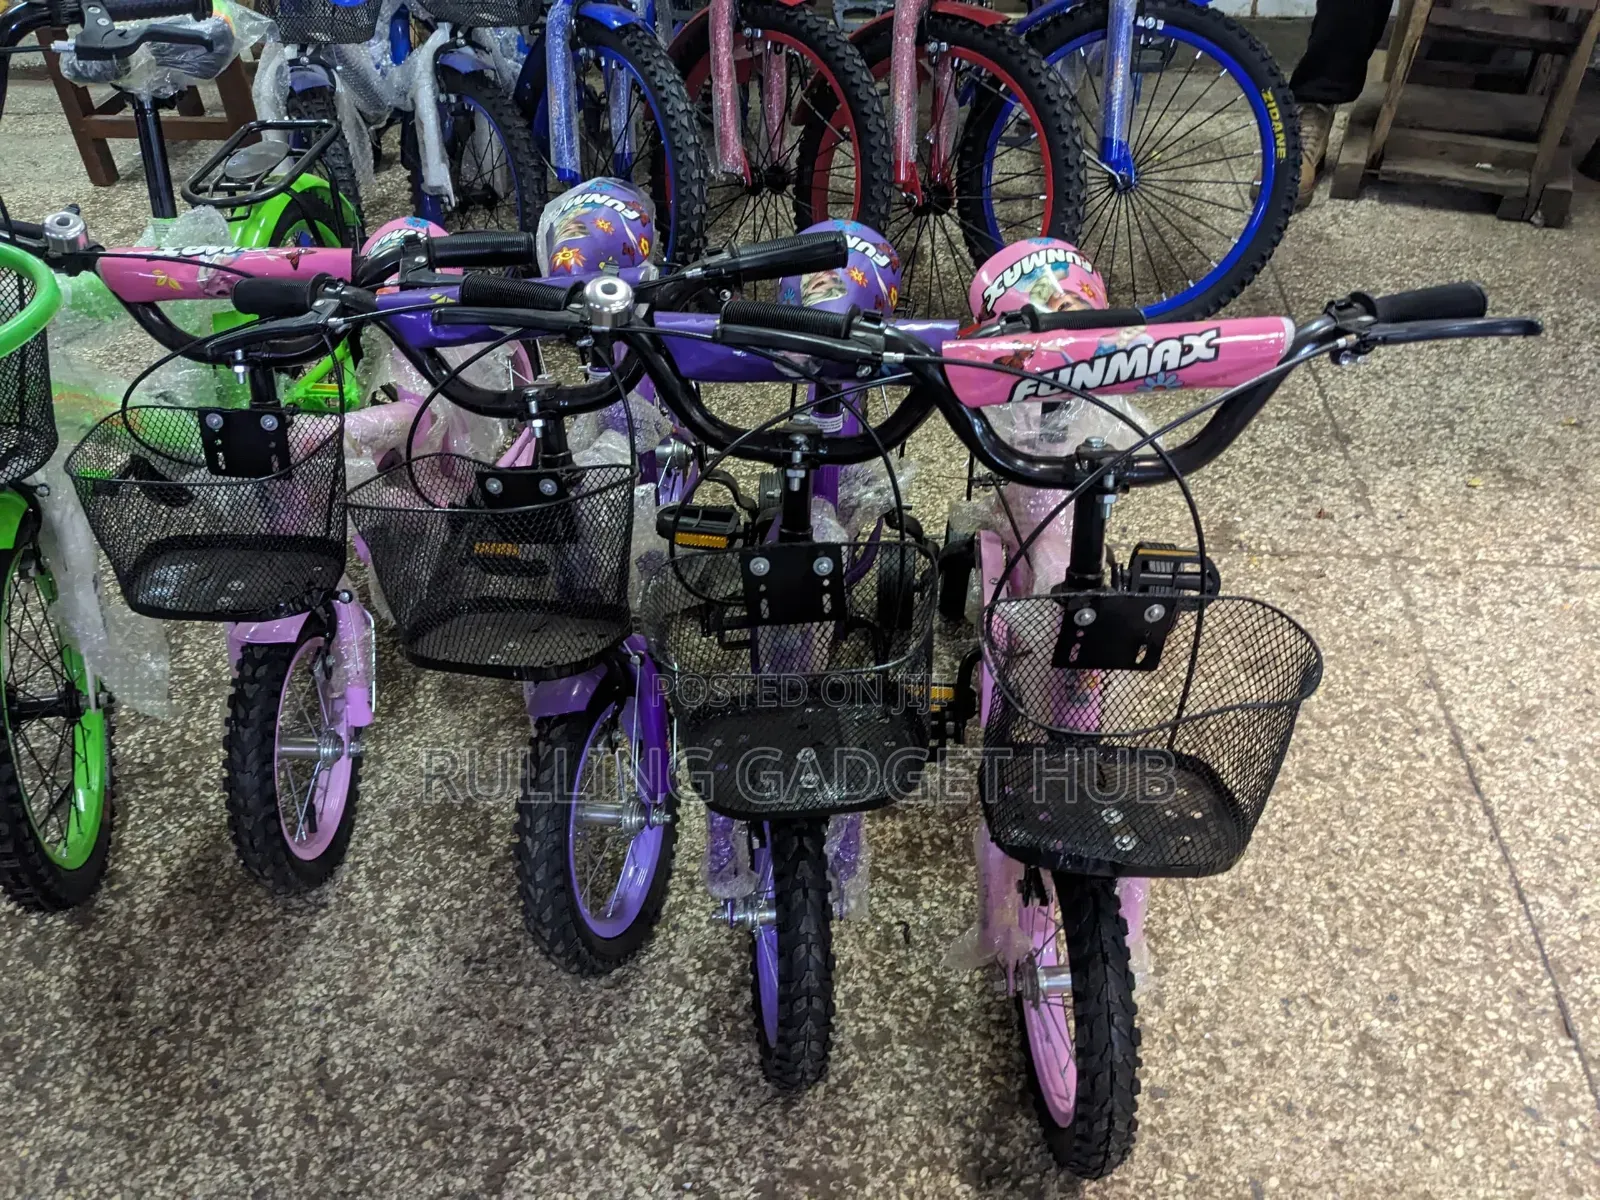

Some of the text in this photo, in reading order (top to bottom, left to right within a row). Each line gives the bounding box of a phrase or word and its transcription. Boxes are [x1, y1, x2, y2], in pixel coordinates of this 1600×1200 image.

[1261, 89, 1287, 159] ZIDANE
[845, 232, 892, 268] FUN
[1007, 326, 1222, 404] FUNMAX
